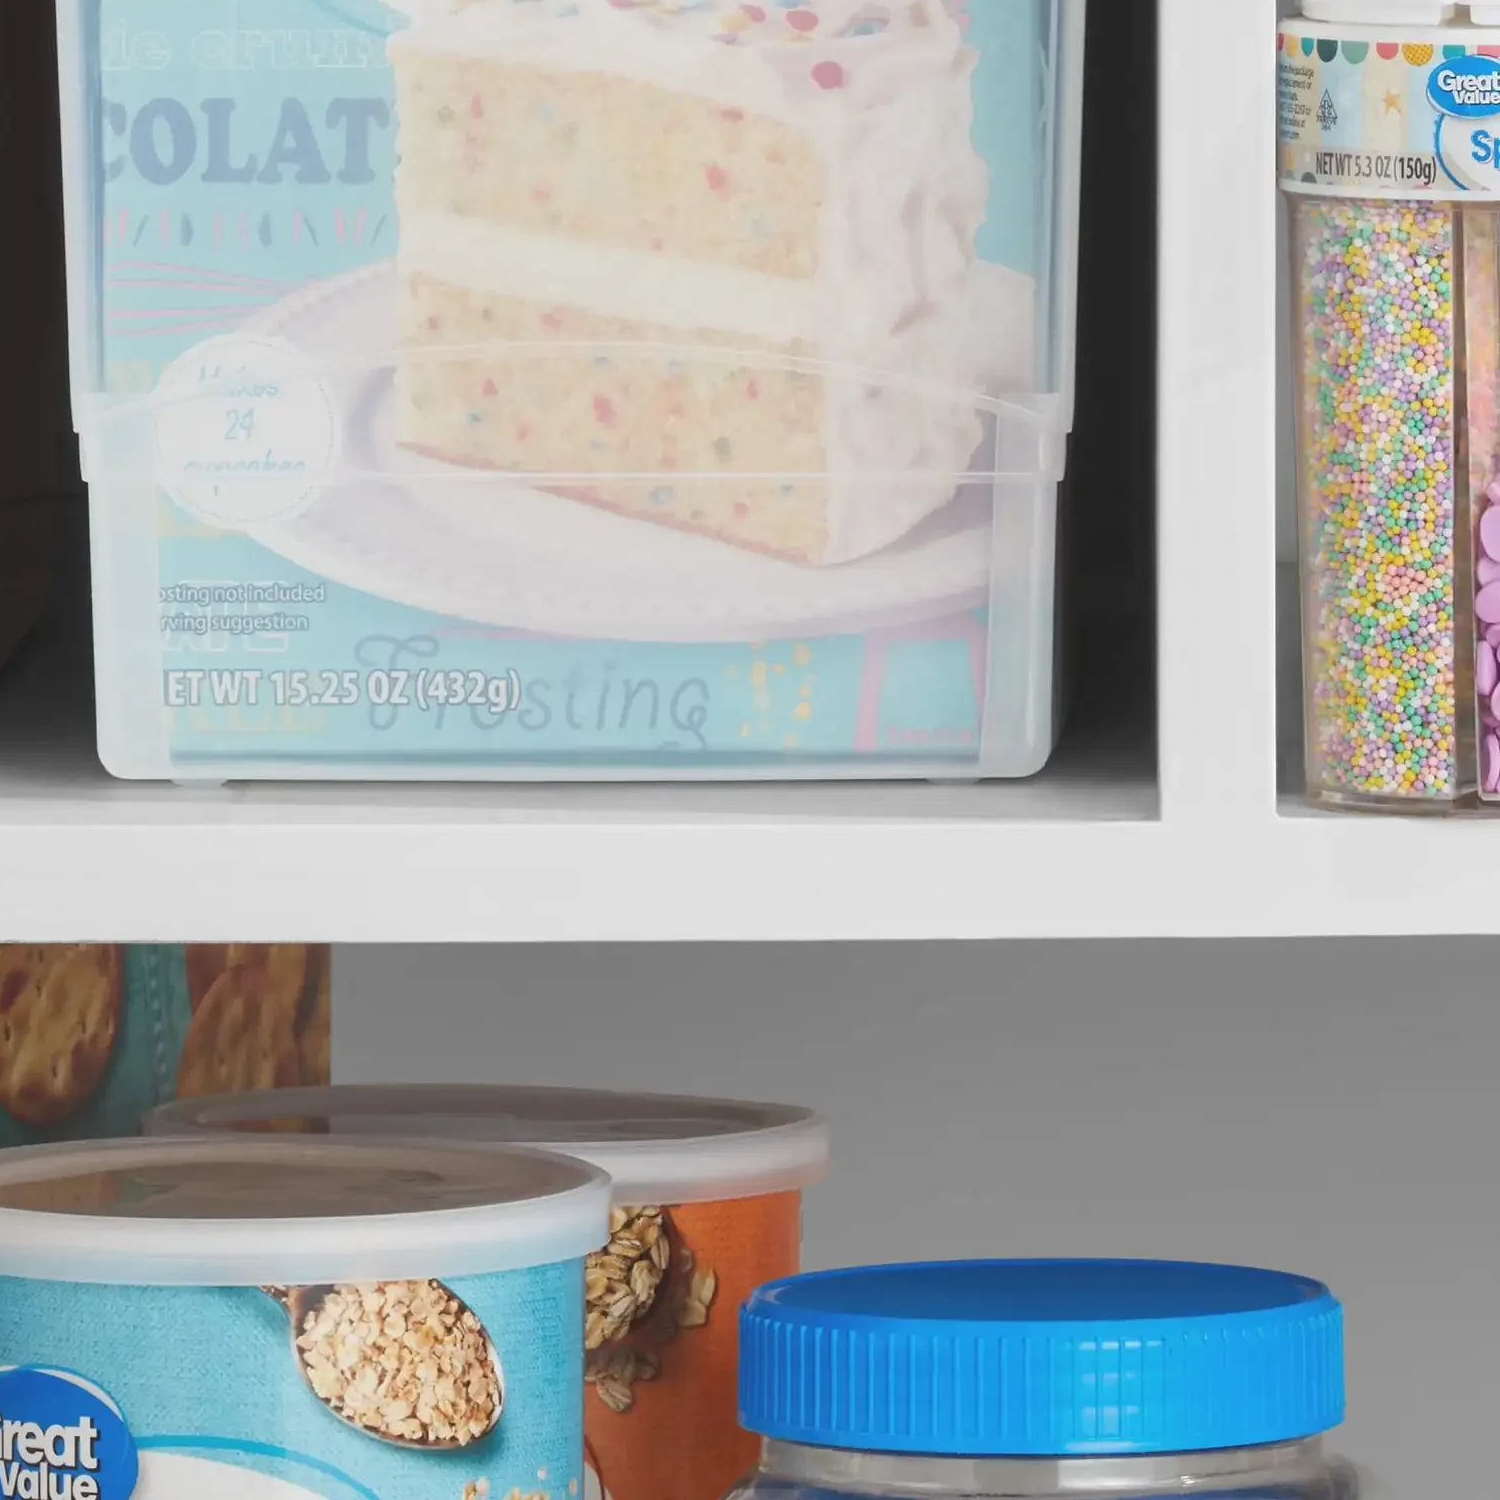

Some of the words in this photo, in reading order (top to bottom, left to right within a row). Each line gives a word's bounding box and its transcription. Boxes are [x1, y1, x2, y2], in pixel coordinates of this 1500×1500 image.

[1437, 69, 1500, 93] Great
[1452, 89, 1500, 105] Value
[1315, 151, 1334, 175] NET
[1336, 152, 1353, 177] WT
[1354, 155, 1373, 179] 5.3
[1375, 156, 1392, 180] OZ
[1394, 156, 1437, 186] (150g)
[223, 408, 255, 441] 24
[213, 584, 247, 604] not
[247, 582, 327, 604] included
[209, 612, 309, 636] suggestion
[164, 668, 206, 707] ET
[209, 668, 263, 707] WT
[269, 668, 360, 707] 15.25
[366, 668, 409, 707] OZ
[415, 667, 522, 714] (432g)
